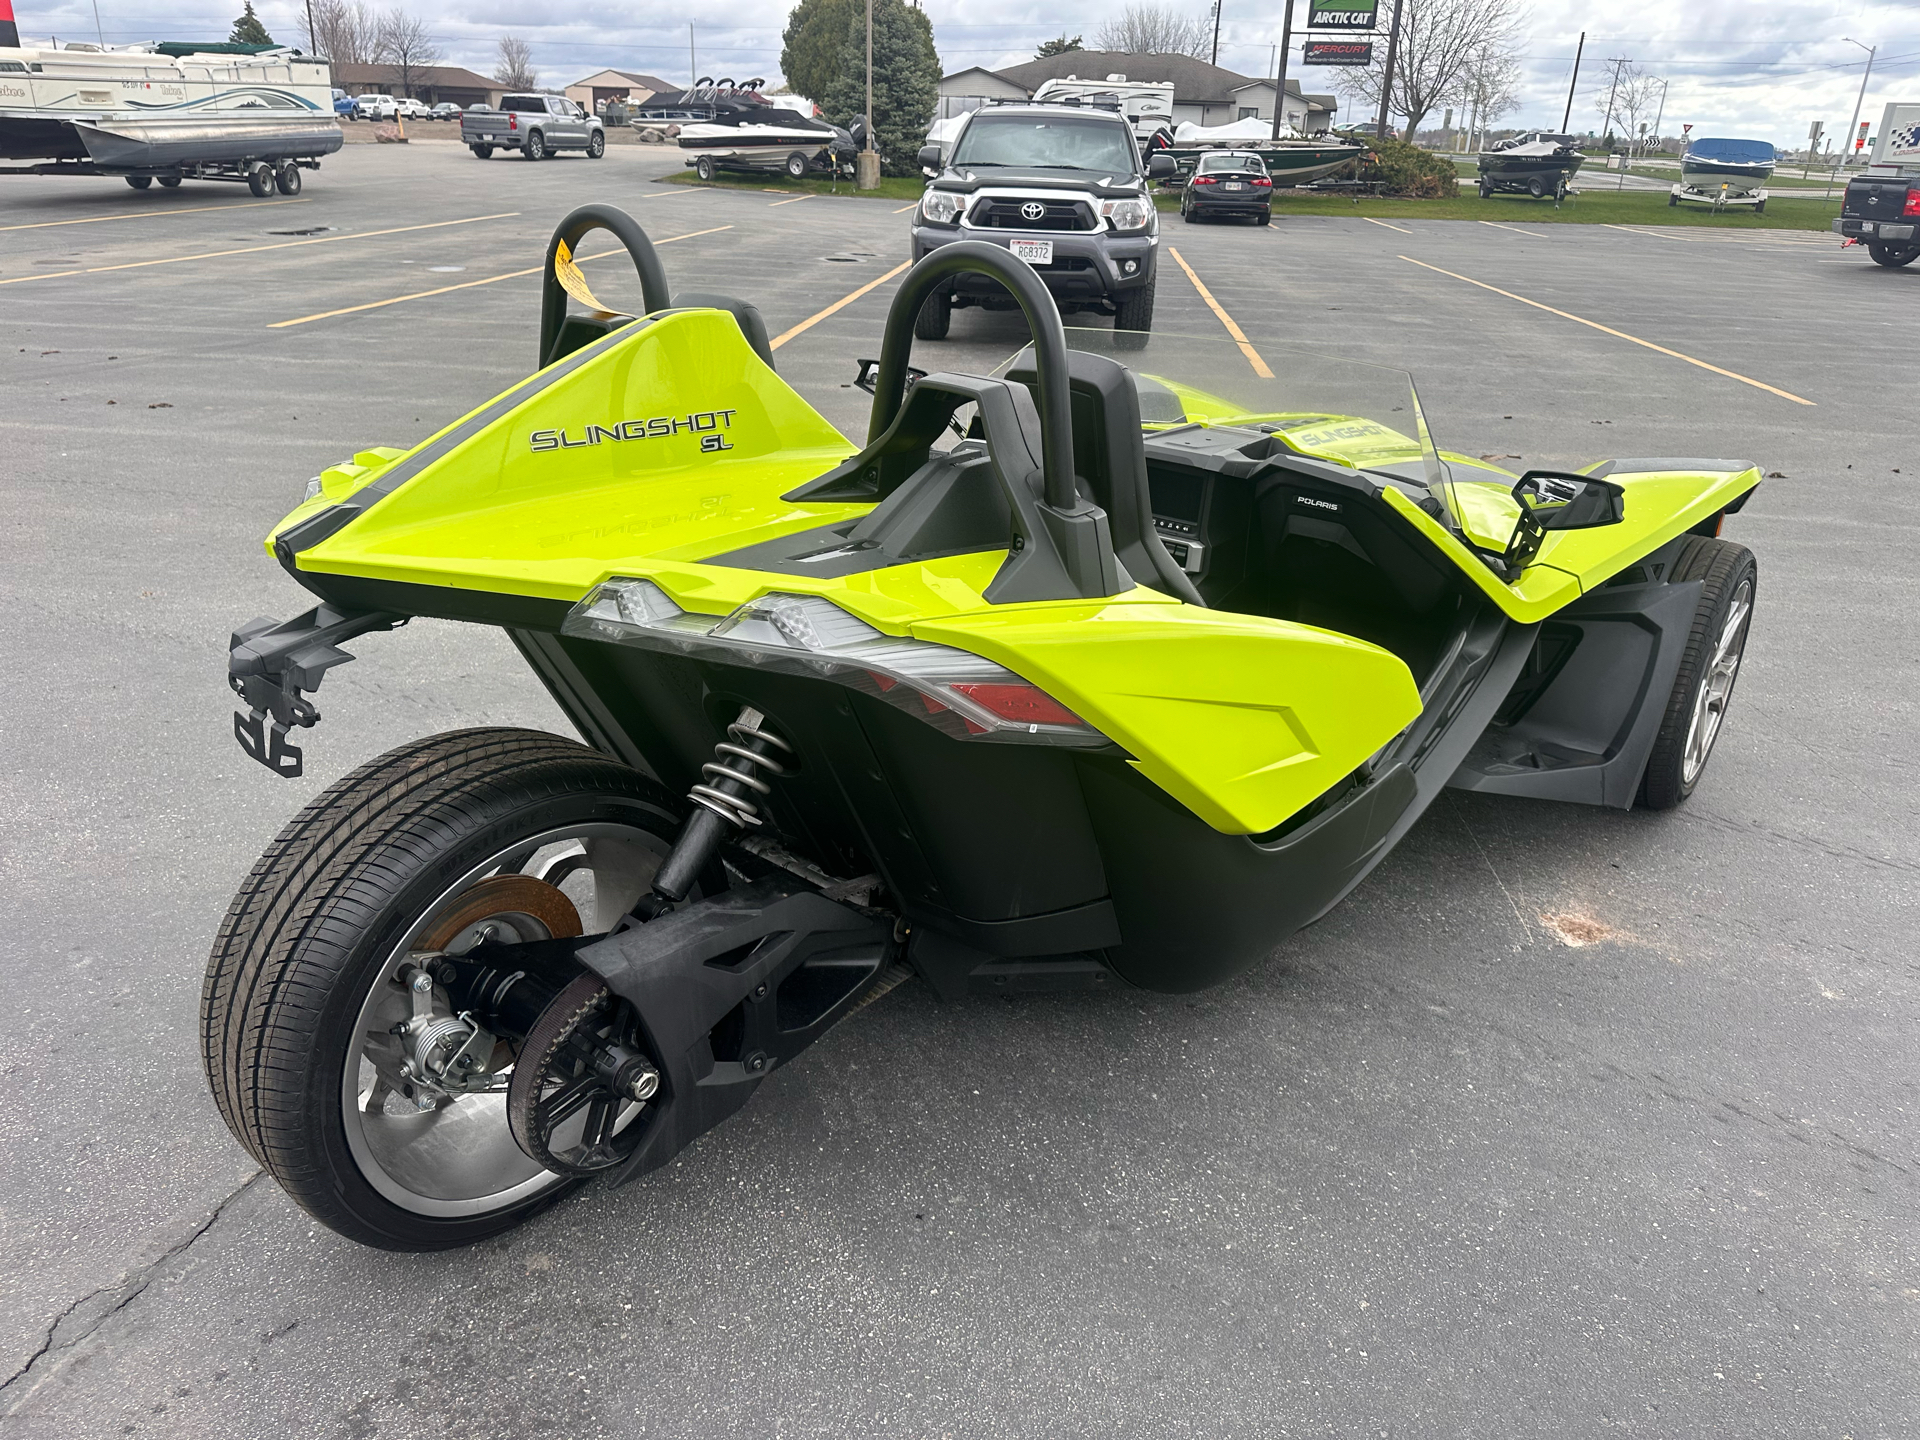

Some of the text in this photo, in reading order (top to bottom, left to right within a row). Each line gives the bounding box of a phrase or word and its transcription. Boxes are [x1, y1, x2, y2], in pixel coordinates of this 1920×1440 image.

[1313, 11, 1370, 25] ARCTIC CAT
[1312, 45, 1368, 53] MERCURY
[1018, 245, 1049, 259] RG8372
[530, 409, 737, 452] SLINGSHOT
[1301, 425, 1388, 446] SLINGSHOT
[700, 434, 735, 453] SL
[1297, 496, 1338, 511] POLARIS
